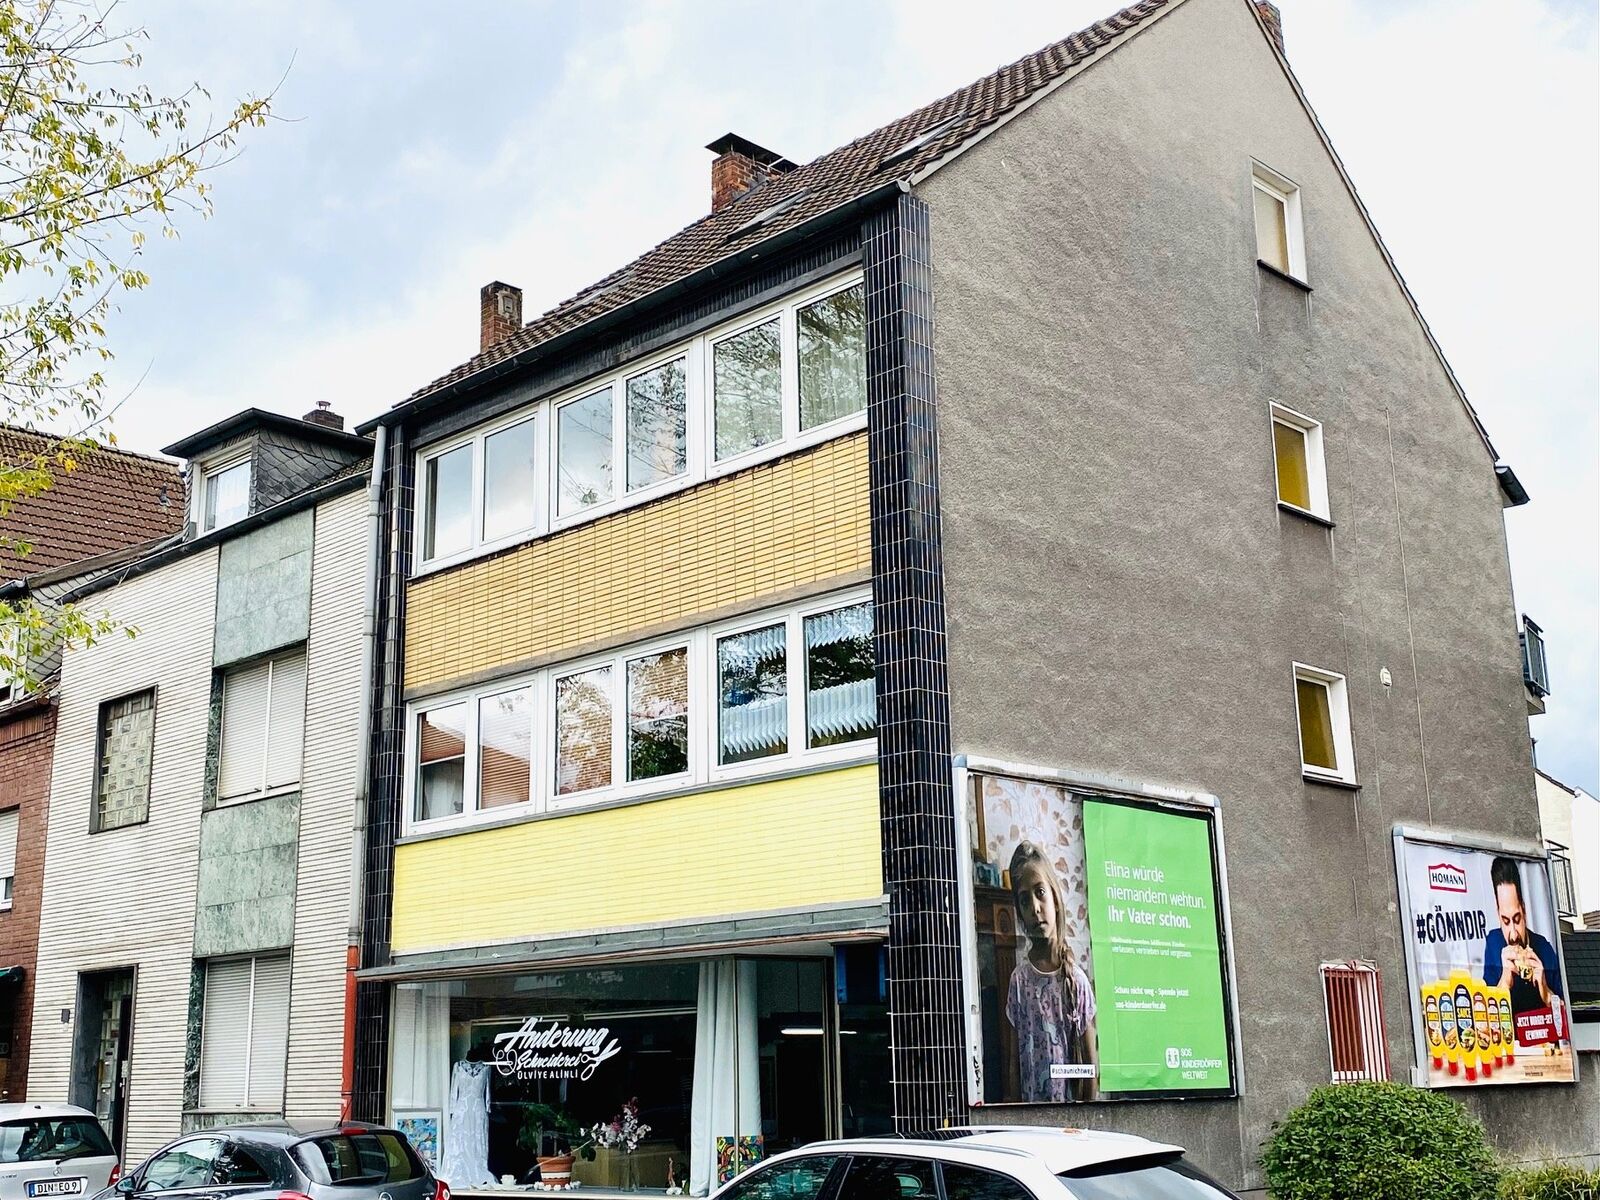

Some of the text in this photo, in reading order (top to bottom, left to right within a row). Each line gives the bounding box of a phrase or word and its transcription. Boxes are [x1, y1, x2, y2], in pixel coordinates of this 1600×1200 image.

[1104, 860, 1164, 883] Elina würde
[1432, 872, 1464, 886] HOMANN
[1107, 883, 1206, 909] niemandem wehtun.
[1108, 904, 1192, 929] Ihr Vater schon.
[1416, 905, 1487, 945] #GÖNNDIR
[494, 1016, 609, 1055] Änderung
[516, 1049, 582, 1071] Schneiderei
[1180, 1047, 1193, 1057] SOS
[37, 1183, 54, 1194] DIN
[72, 1181, 77, 1191] 9
